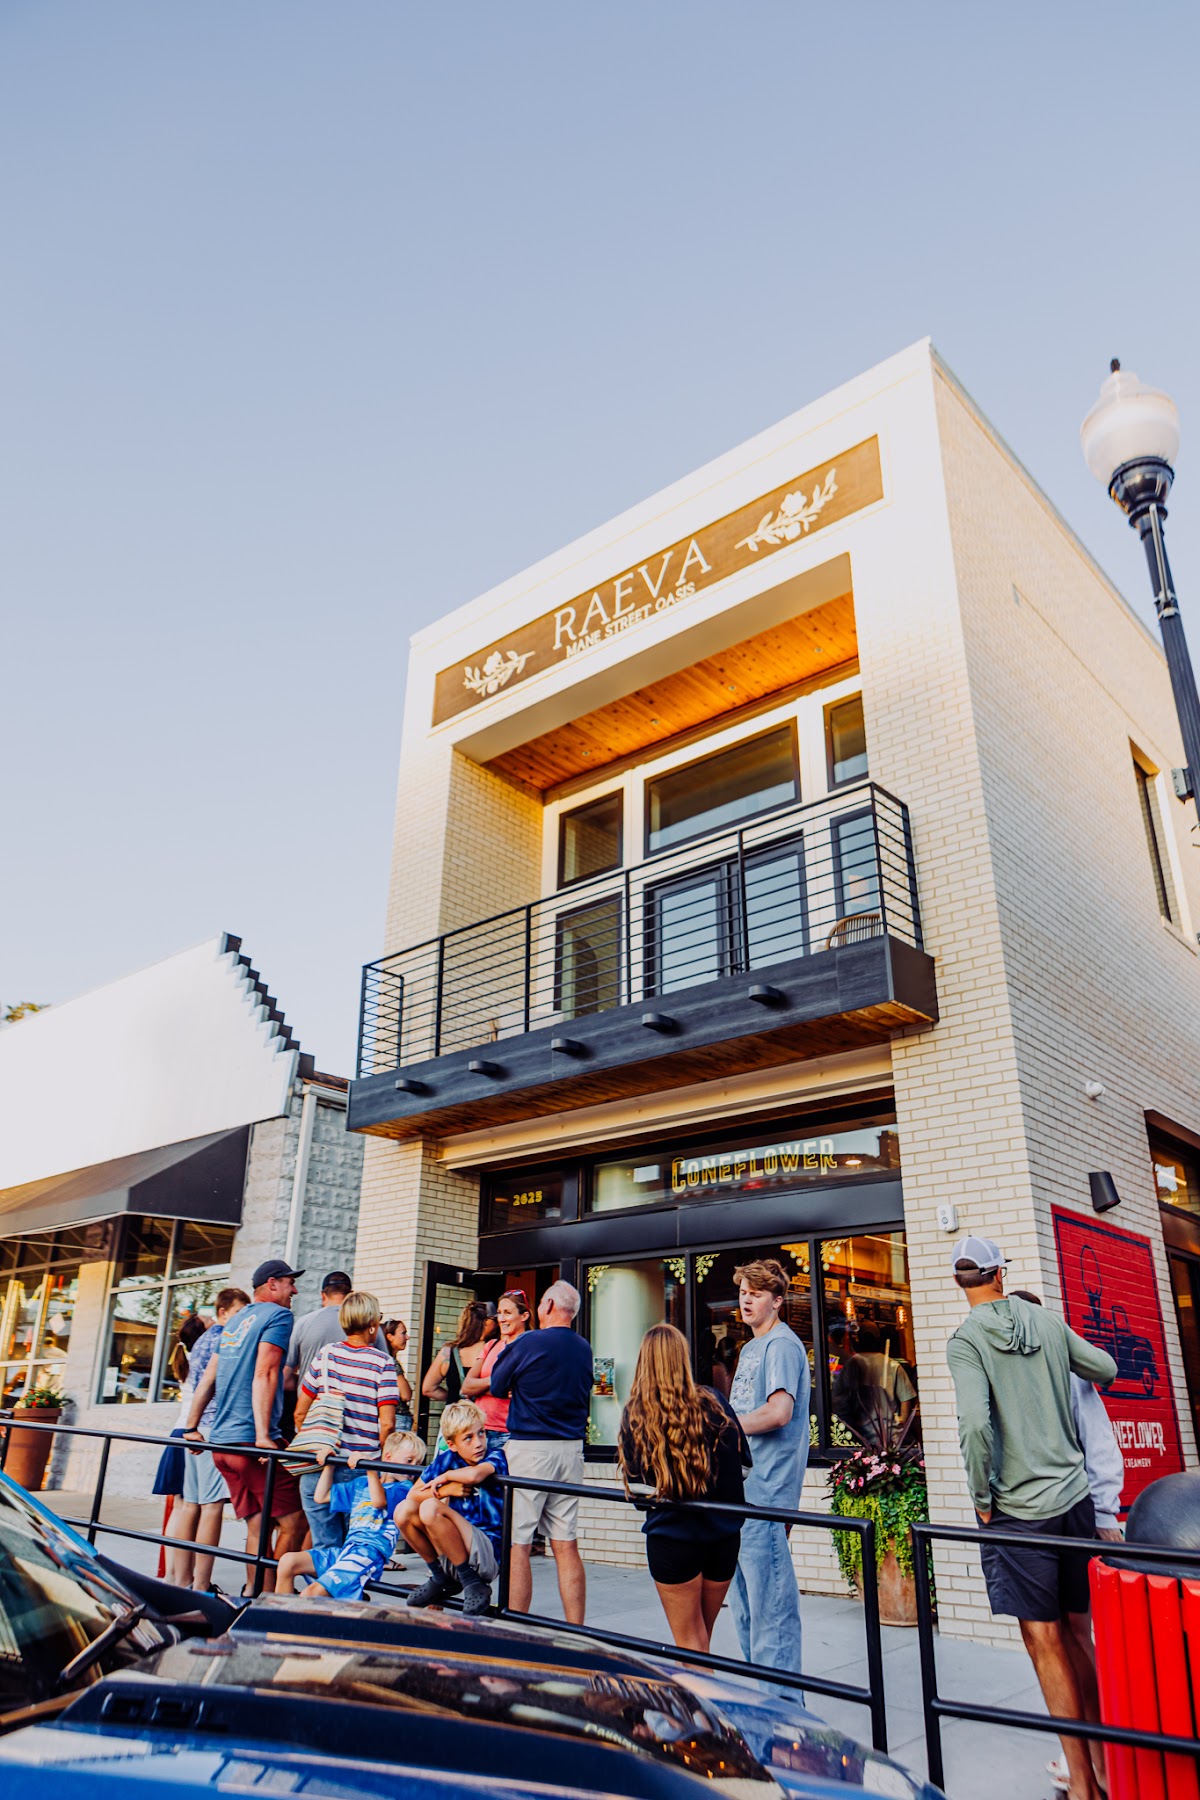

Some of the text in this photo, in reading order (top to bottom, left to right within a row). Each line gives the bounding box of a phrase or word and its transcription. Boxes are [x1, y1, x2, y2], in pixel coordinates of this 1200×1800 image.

[552, 538, 712, 650] RAEVA
[566, 581, 696, 658] MANE STREET OASIS
[671, 1138, 838, 1194] CONEFLOWER
[512, 1190, 543, 1206] 2625
[1111, 1420, 1166, 1456] NEFLOWER
